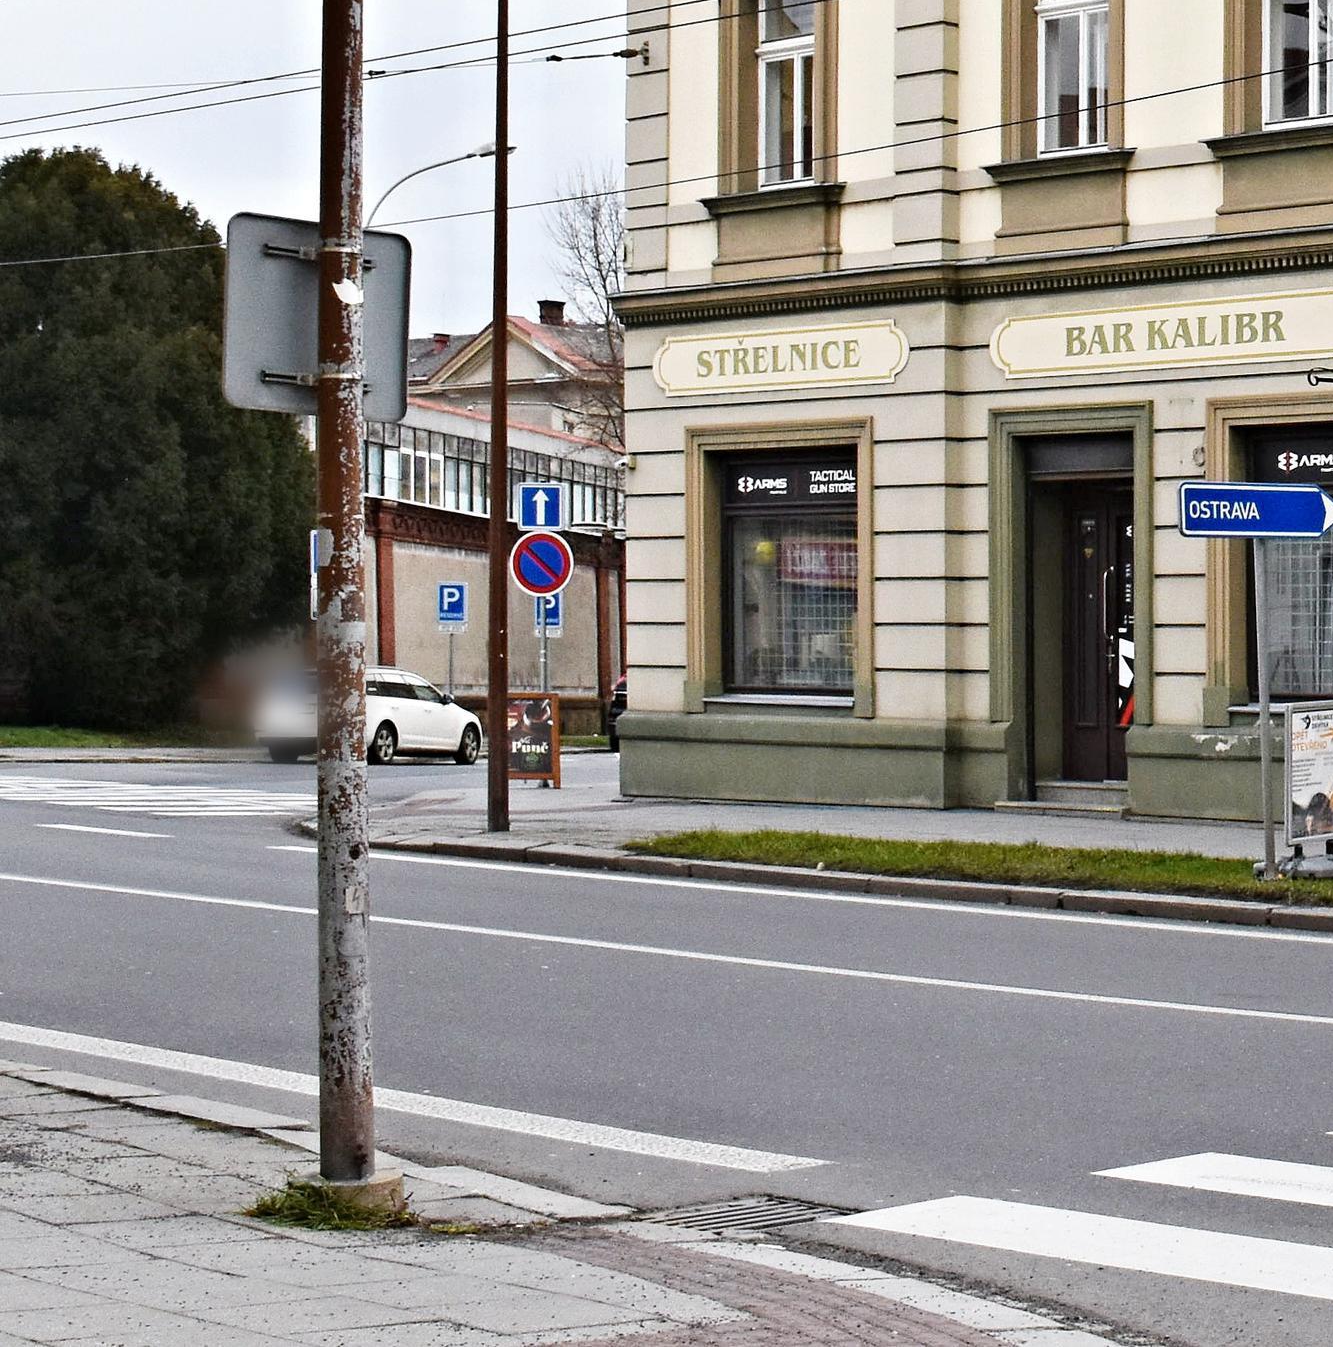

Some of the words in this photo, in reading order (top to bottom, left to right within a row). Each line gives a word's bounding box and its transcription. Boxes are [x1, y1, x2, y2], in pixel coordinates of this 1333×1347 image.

[1065, 322, 1135, 357] BAR
[1147, 310, 1286, 351] KALIBR
[696, 338, 861, 378] STŘELNICE
[809, 470, 856, 483] TACTICAL
[809, 483, 828, 494] GUN
[829, 483, 856, 493] STORE
[1189, 501, 1260, 520] OSTRAVA
[443, 588, 460, 610] P
[512, 741, 549, 753] Punč
